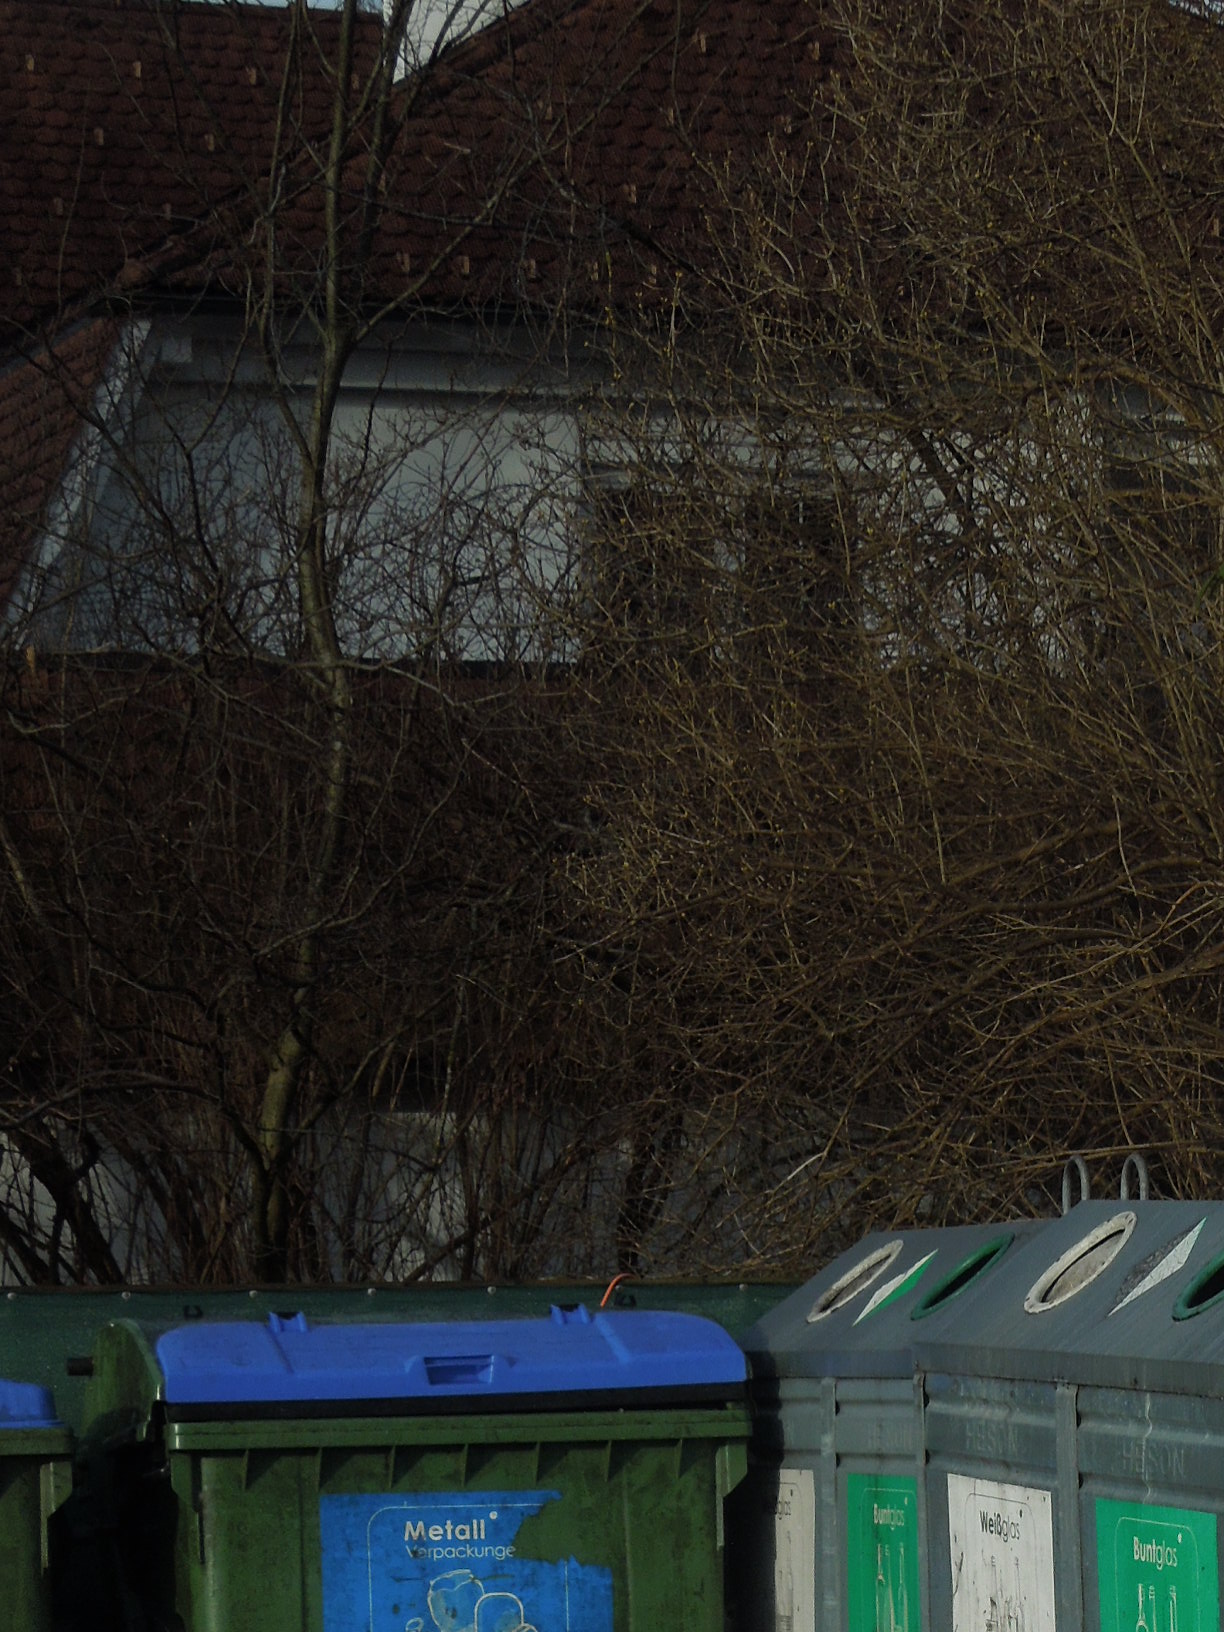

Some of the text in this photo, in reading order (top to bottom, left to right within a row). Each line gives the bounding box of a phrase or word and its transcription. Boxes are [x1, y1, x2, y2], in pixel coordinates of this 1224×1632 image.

[1123, 1441, 1185, 1477] HESON
[404, 1519, 485, 1541] Metall
[873, 1503, 905, 1532] Buntglas
[980, 1510, 1020, 1542] Weißglas
[1133, 1536, 1178, 1571] Buntglas
